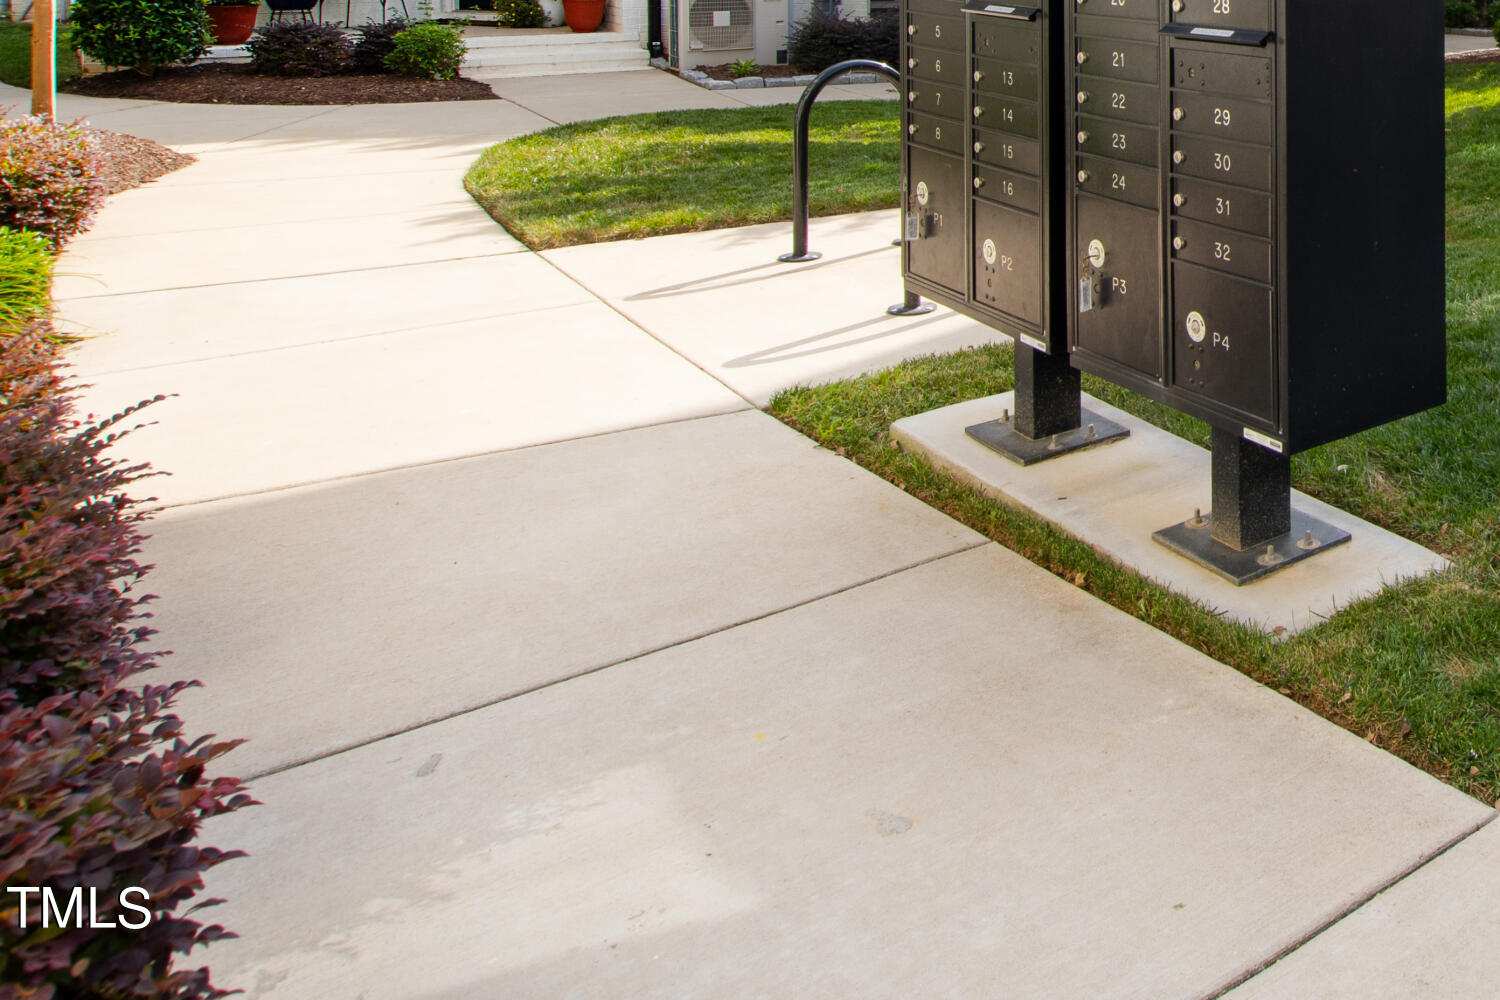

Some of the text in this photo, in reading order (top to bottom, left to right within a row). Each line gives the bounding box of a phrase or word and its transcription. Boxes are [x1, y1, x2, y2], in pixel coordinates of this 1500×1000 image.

[1112, 51, 1125, 68] 21
[1002, 71, 1014, 86] 13
[1111, 92, 1126, 110] 22
[1002, 107, 1014, 123] 14
[1214, 107, 1231, 127] 29
[1112, 132, 1126, 150] 23
[1002, 143, 1014, 159] 15
[1213, 152, 1231, 172] 30
[1002, 180, 1014, 196] 16
[1112, 173, 1126, 191] 24
[1215, 197, 1230, 216] 31
[933, 212, 943, 227] P1
[1214, 241, 1231, 262] 32
[1001, 255, 1013, 271] P2
[1112, 276, 1127, 295] P3
[1212, 331, 1230, 351] P4
